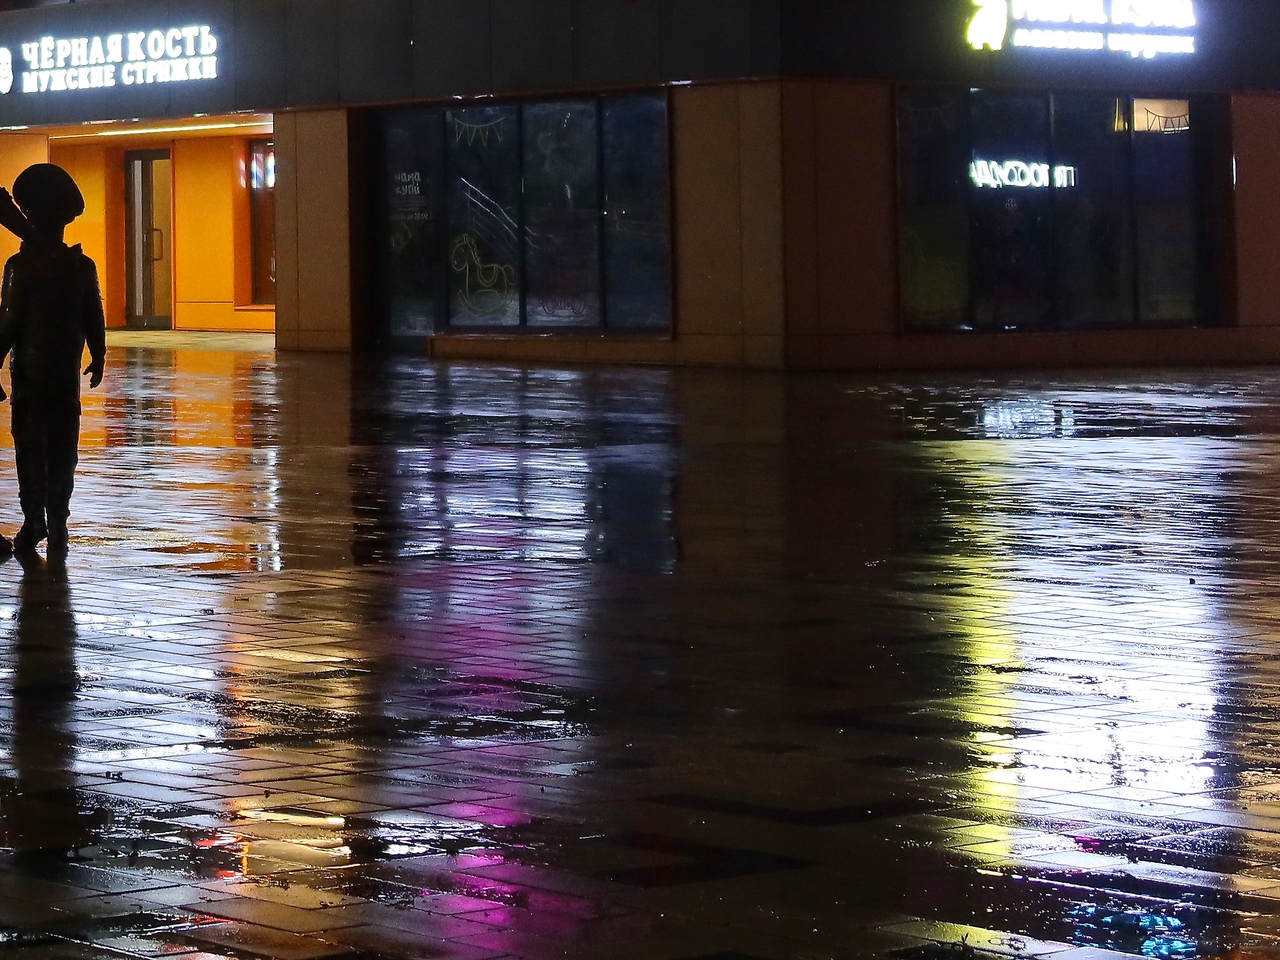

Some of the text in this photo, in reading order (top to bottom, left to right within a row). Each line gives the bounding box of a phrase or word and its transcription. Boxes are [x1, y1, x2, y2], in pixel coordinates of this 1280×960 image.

[22, 26, 218, 70] ЧЁРНАЯ КОСТЬ
[23, 56, 218, 93] МУЖСКИЕ СТРИЖКИ
